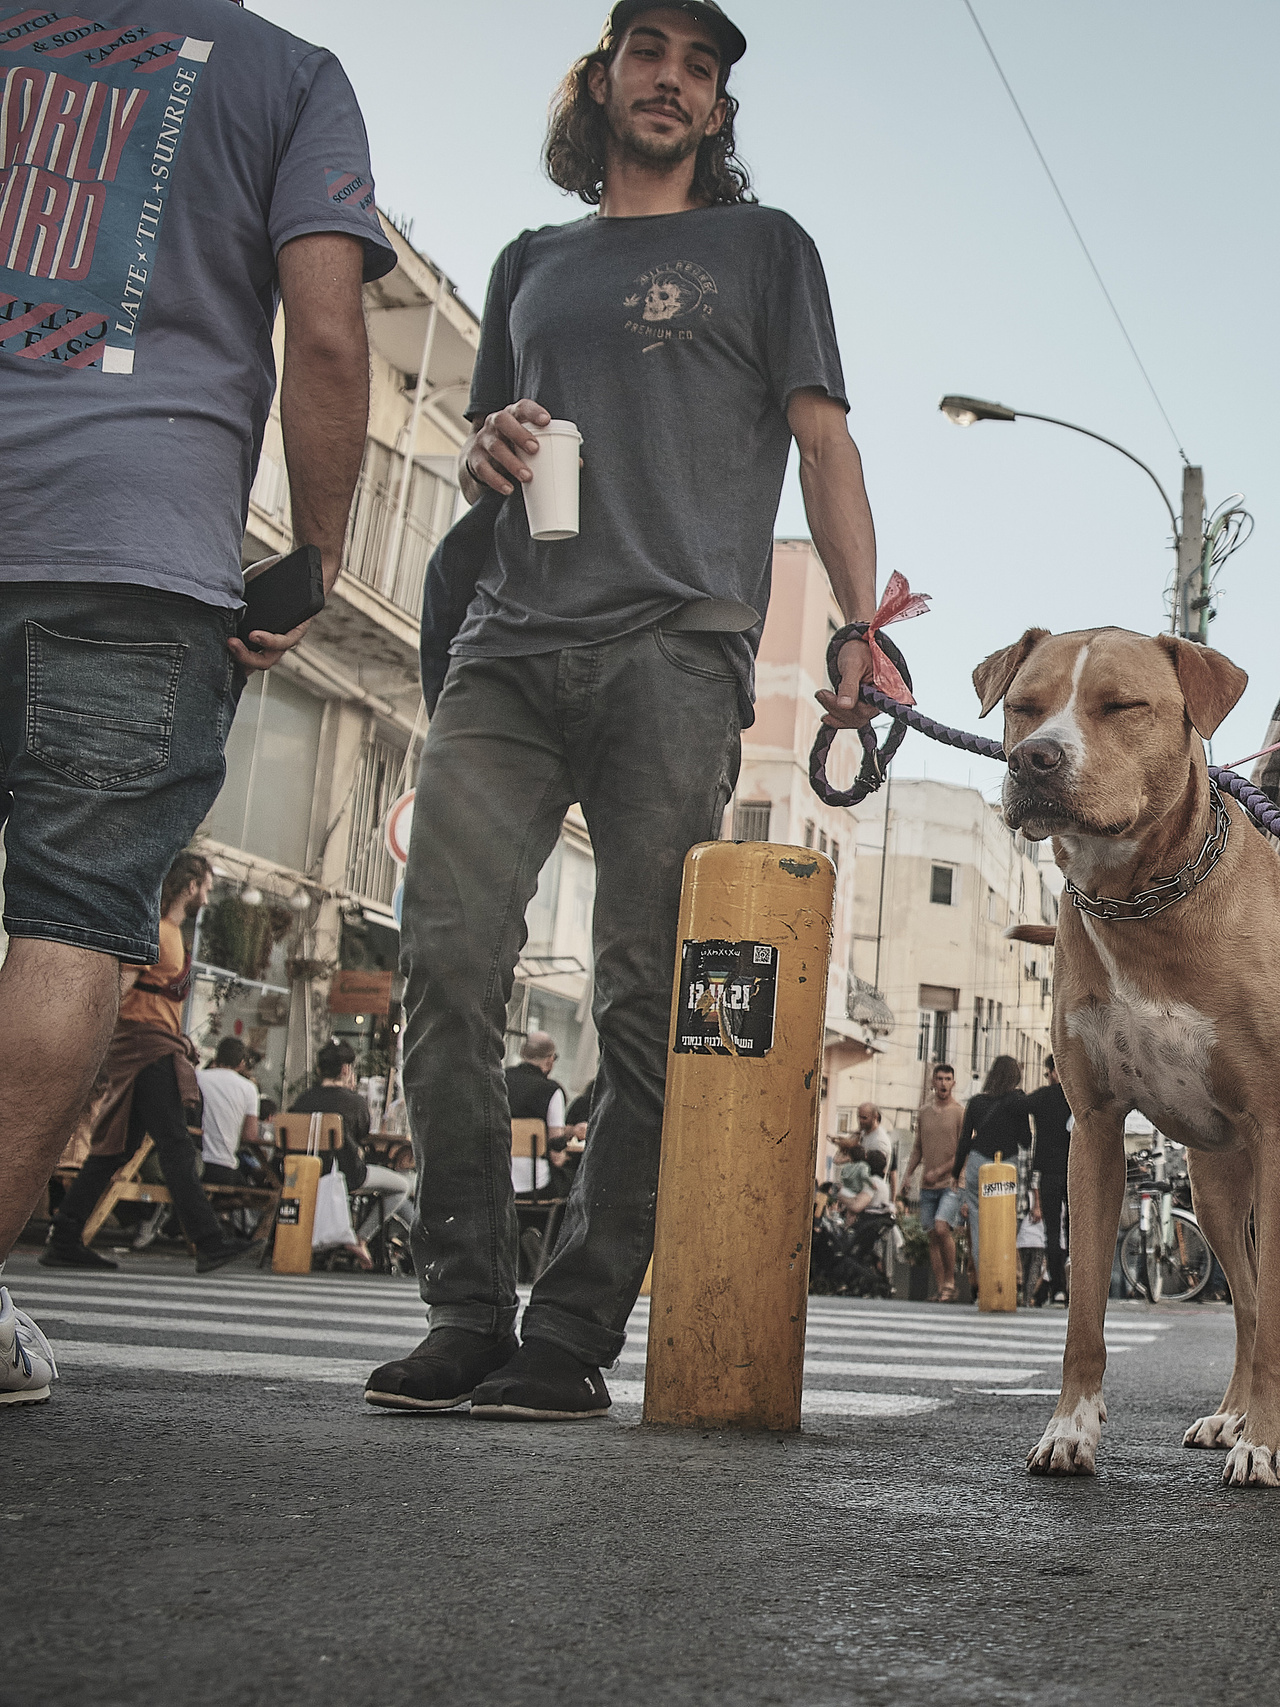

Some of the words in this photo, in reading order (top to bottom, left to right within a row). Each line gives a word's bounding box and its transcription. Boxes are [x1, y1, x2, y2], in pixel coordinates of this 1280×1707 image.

[0, 12, 61, 44] COTCH
[33, 42, 49, 53] &
[53, 22, 107, 48] SODA
[0, 66, 150, 182] ARLY
[115, 264, 148, 336] LATE
[151, 67, 197, 179] SUNRISE
[333, 177, 363, 204] SCOTCH
[0, 165, 107, 281] IRD
[624, 320, 672, 339] PREMIUM
